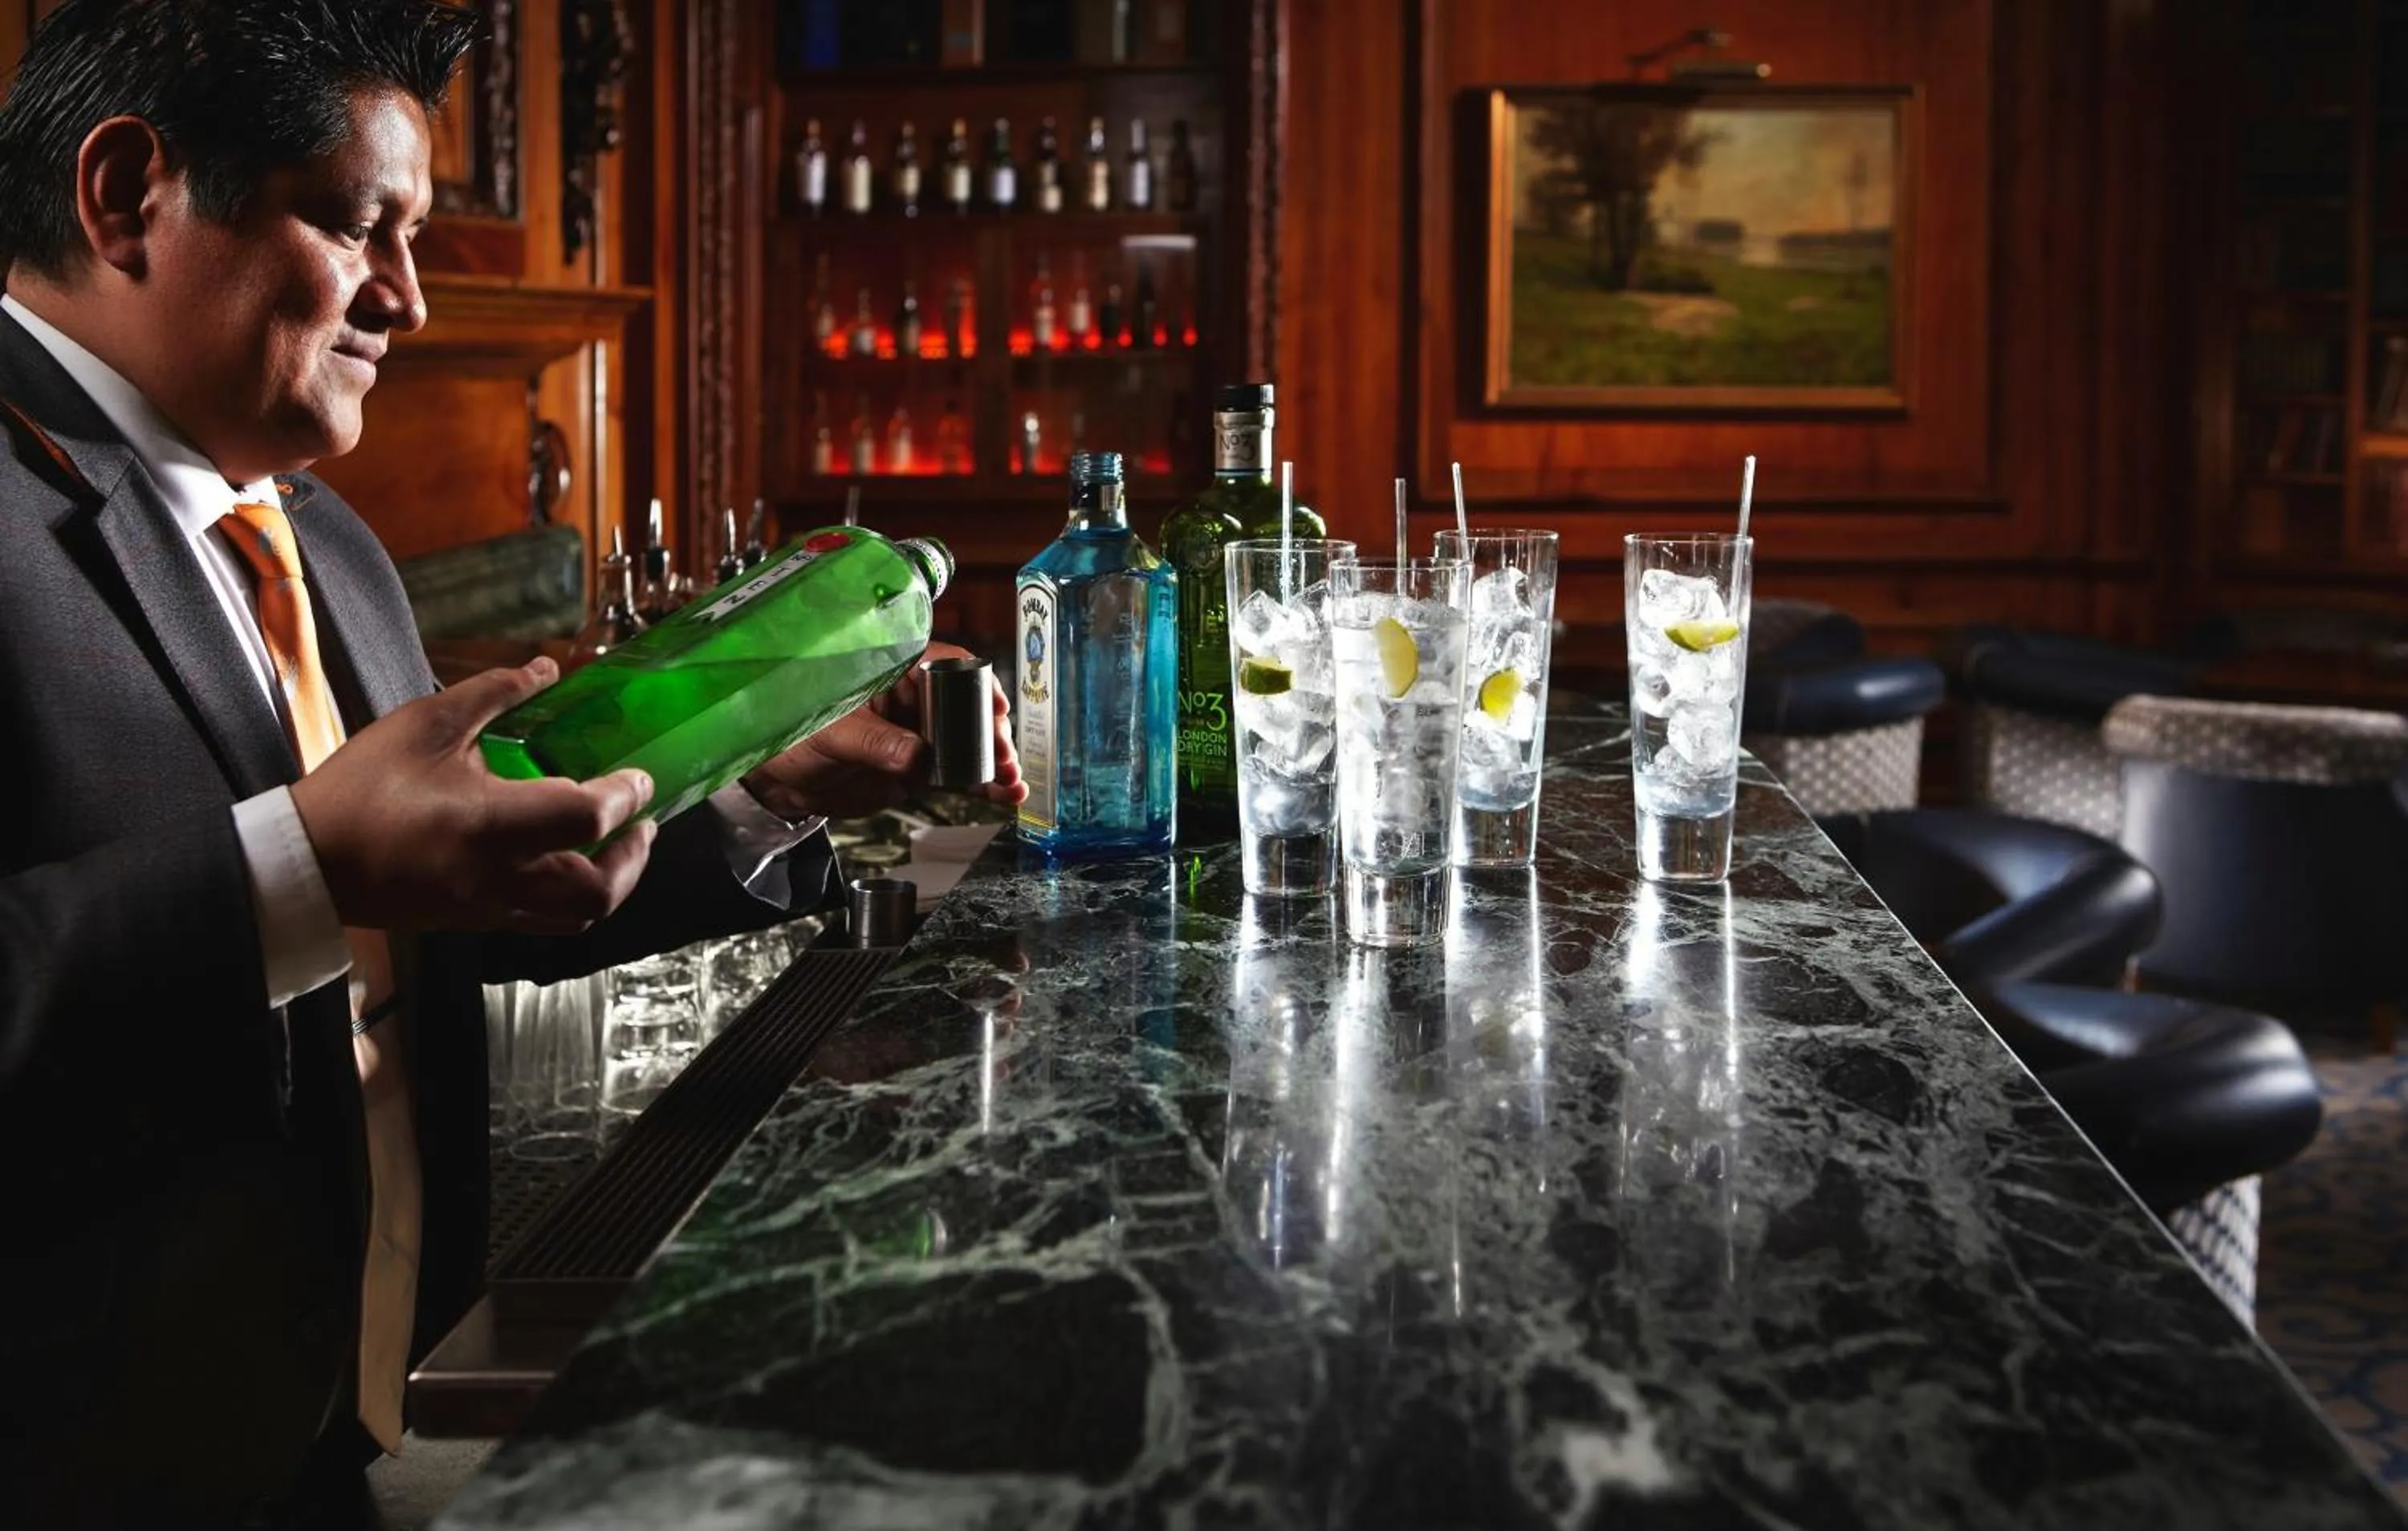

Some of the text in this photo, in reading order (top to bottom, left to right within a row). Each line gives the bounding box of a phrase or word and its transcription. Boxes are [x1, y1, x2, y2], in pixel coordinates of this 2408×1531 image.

[1178, 729, 1227, 744] LONDON
[1178, 740, 1227, 757] DRY GIN
